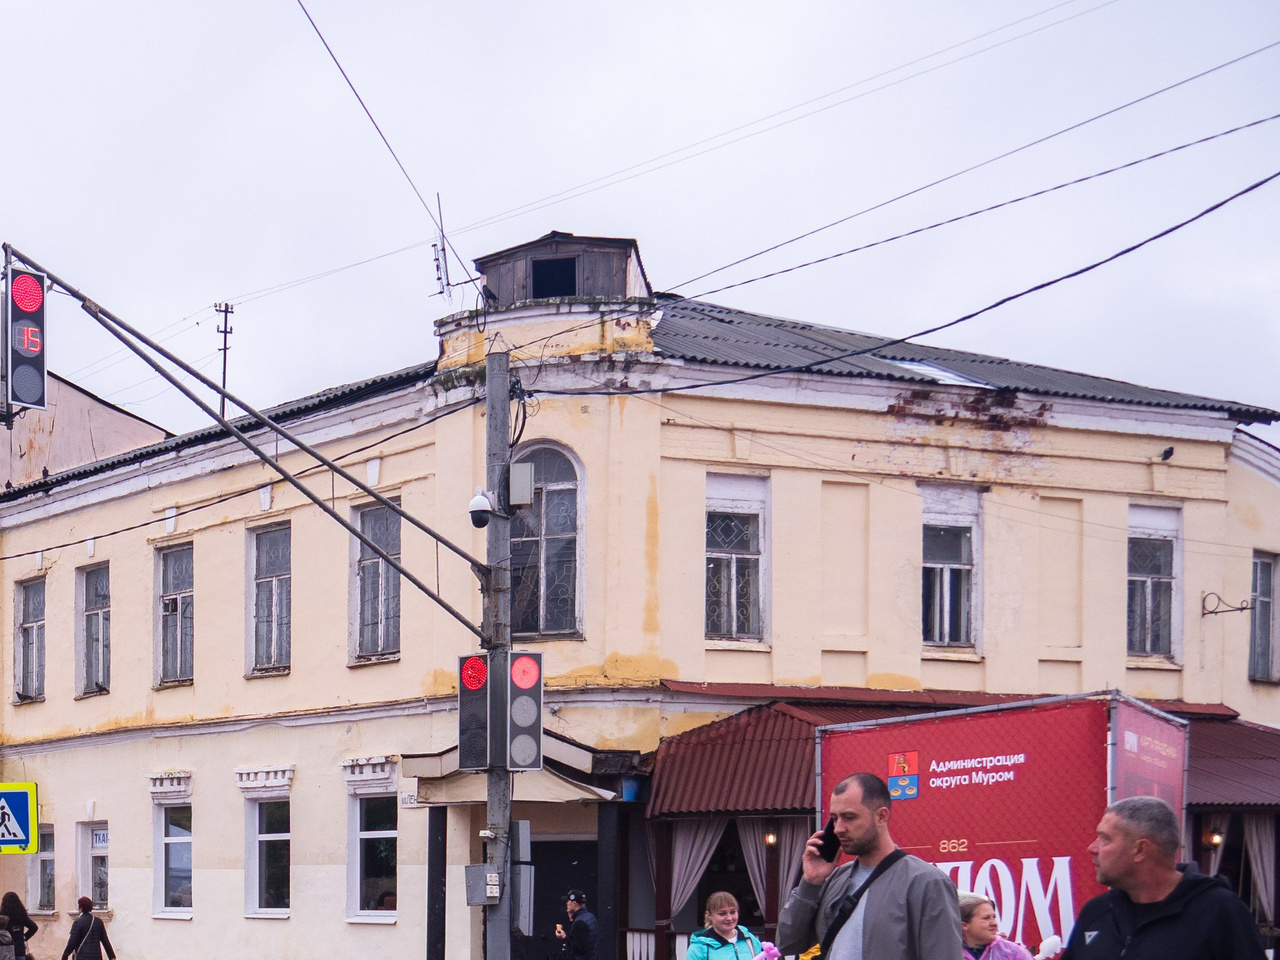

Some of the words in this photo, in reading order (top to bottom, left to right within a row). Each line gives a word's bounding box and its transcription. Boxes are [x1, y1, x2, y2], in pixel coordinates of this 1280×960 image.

[23, 326, 42, 353] 15
[929, 753, 1025, 773] Администрация
[929, 774, 969, 788] округа
[971, 769, 1015, 786] Муром
[939, 838, 968, 853] 862
